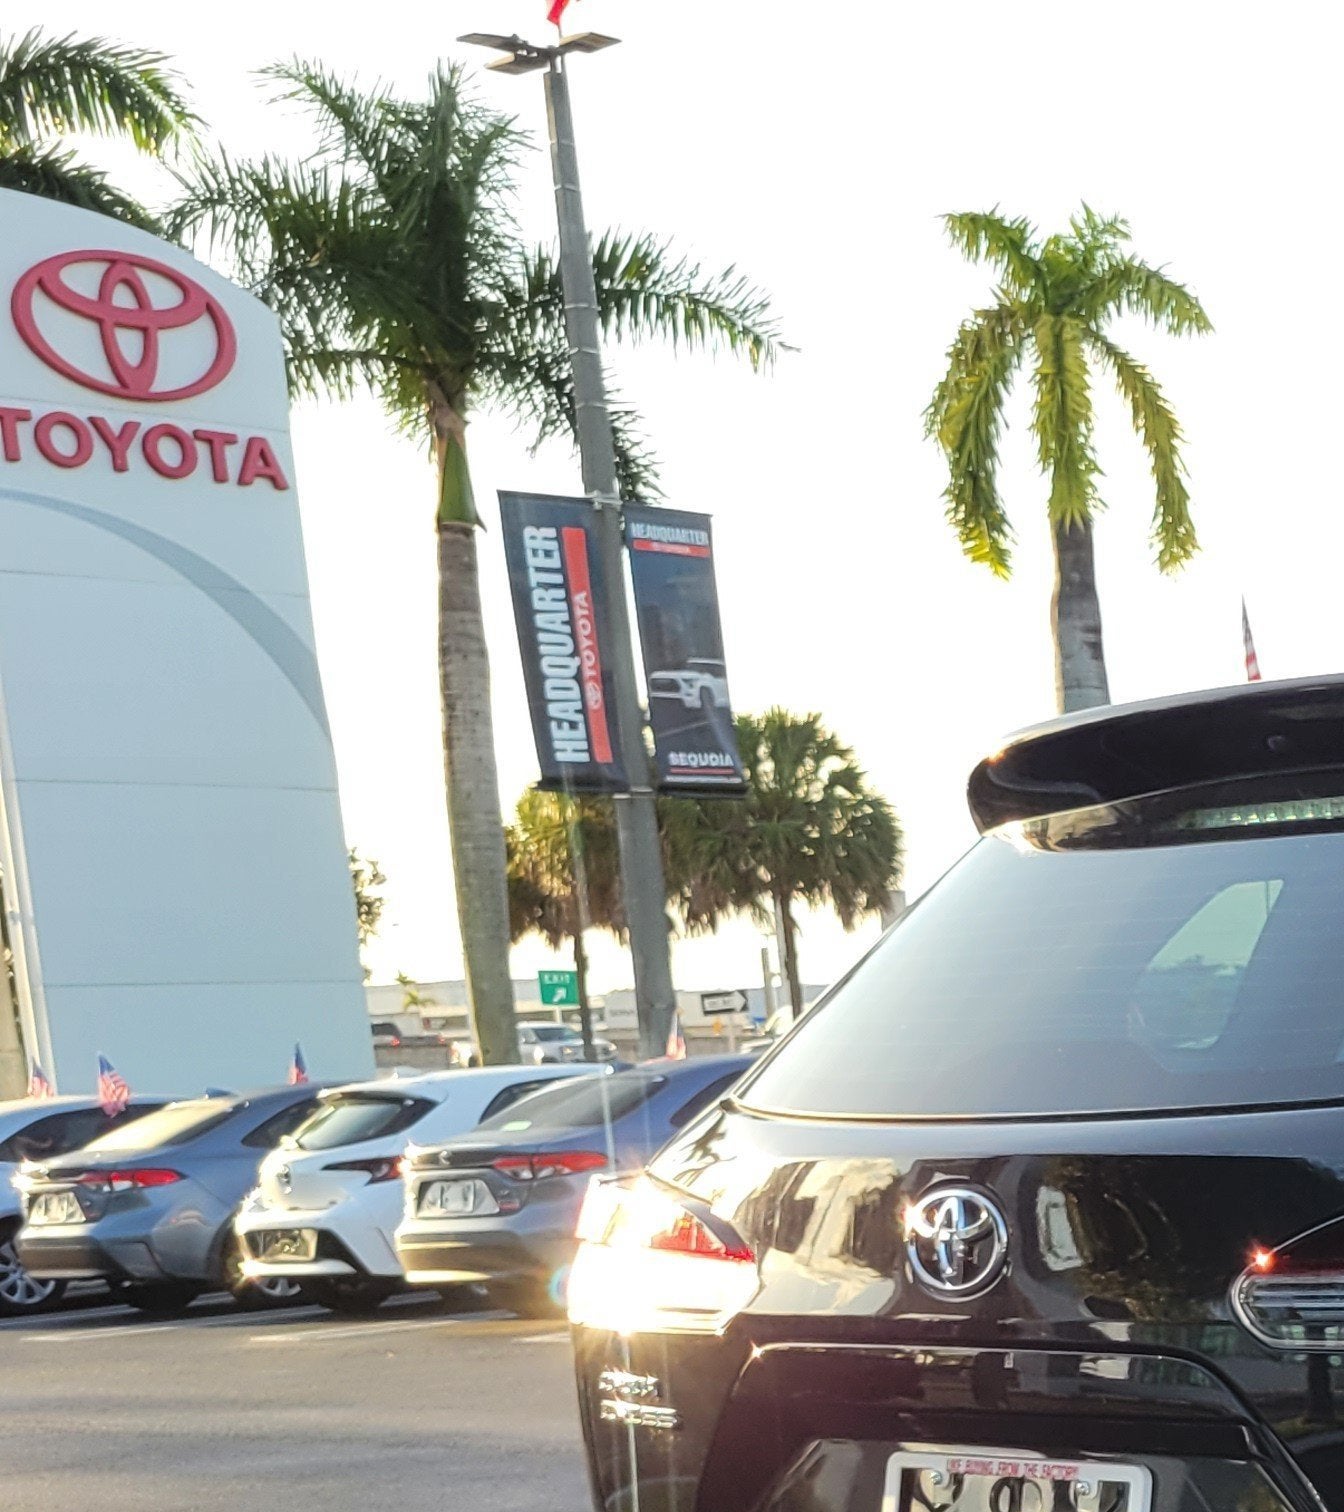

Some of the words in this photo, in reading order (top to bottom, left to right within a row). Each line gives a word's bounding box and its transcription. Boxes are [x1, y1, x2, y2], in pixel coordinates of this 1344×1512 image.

[0, 407, 289, 490] TOYOTA
[523, 525, 591, 763] HEADQUARTER
[573, 591, 600, 681] TOYOTA
[669, 752, 735, 767] SEQUOIA
